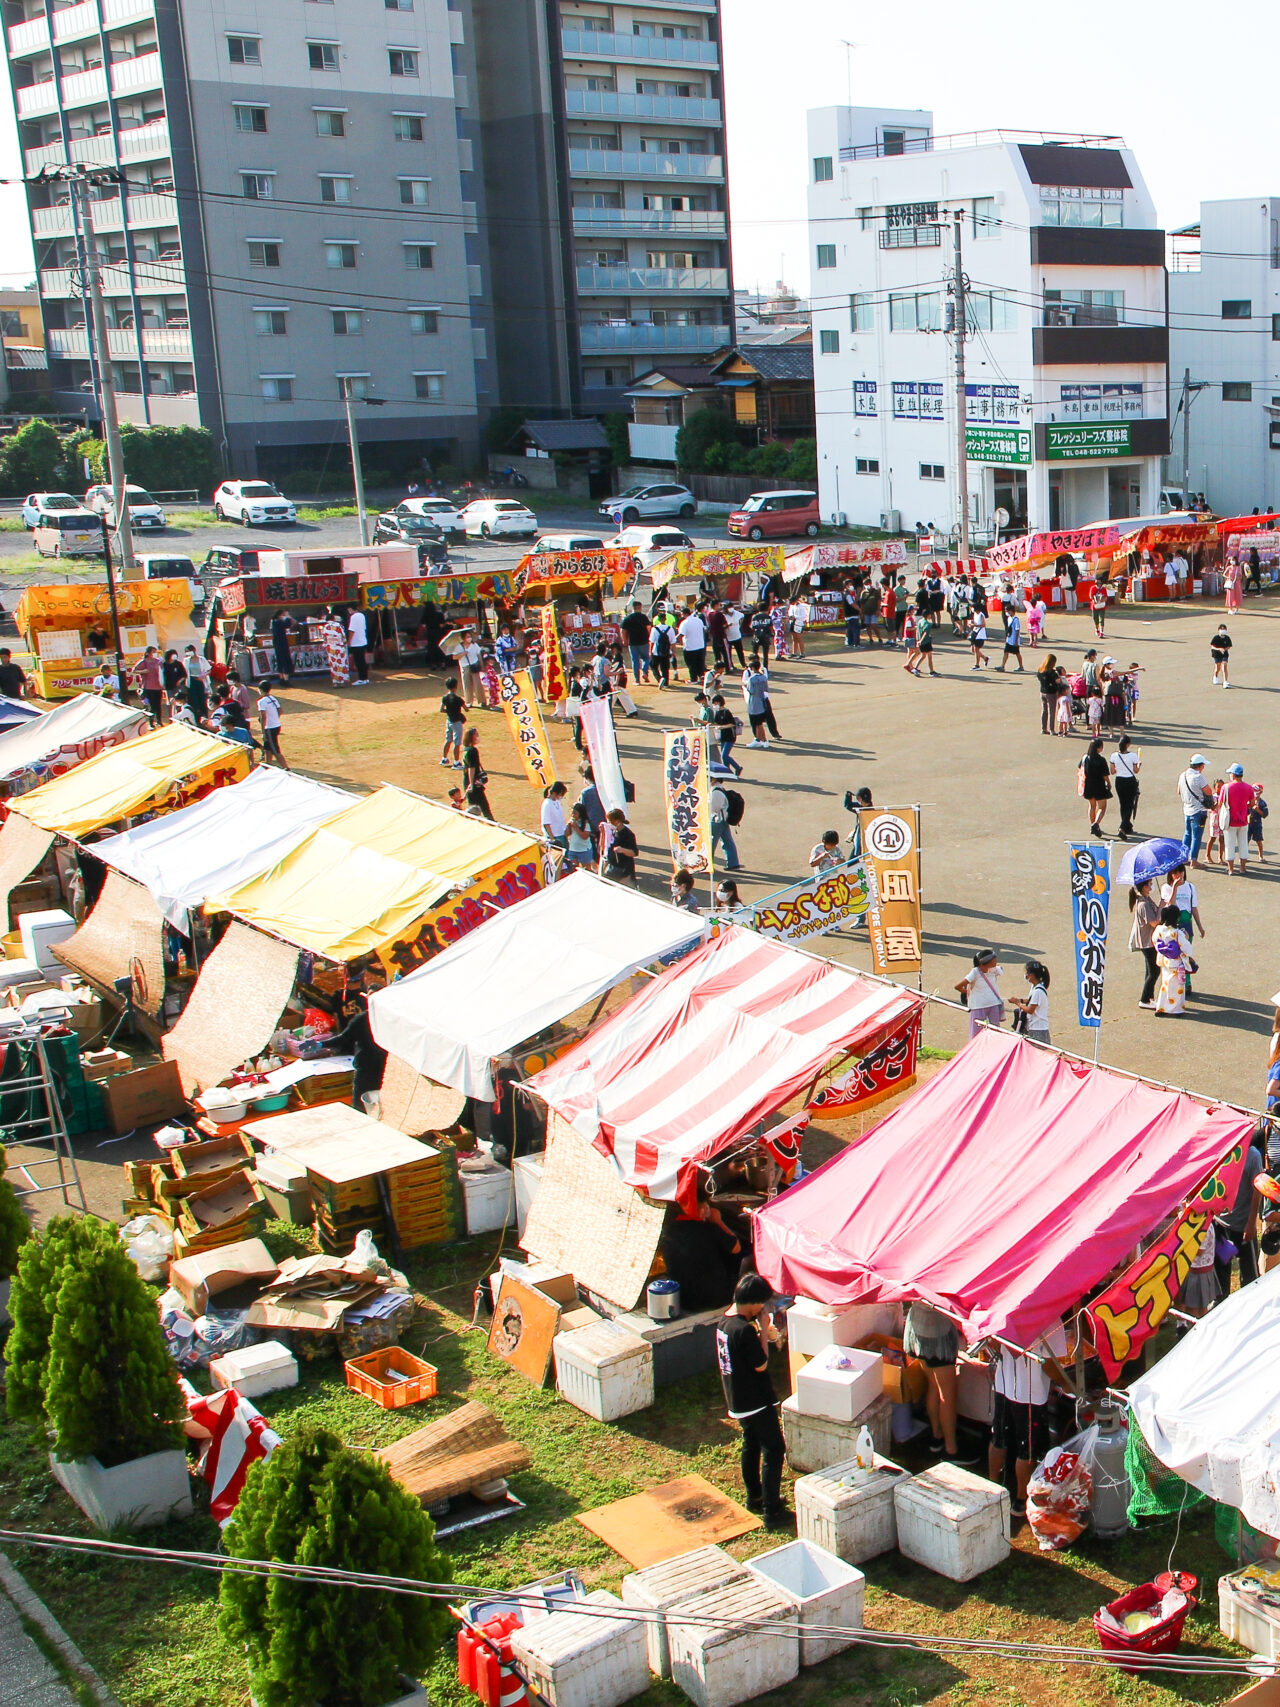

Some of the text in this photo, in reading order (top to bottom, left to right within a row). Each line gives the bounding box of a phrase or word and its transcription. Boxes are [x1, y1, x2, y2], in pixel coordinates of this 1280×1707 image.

[1020, 436, 1028, 450] P
[1051, 533, 1095, 549] やきそば
[728, 553, 769, 572] チーズ
[992, 542, 1028, 566] やきそば
[265, 580, 341, 601] 焼まんじゅう
[512, 699, 548, 786] じゃがバター
